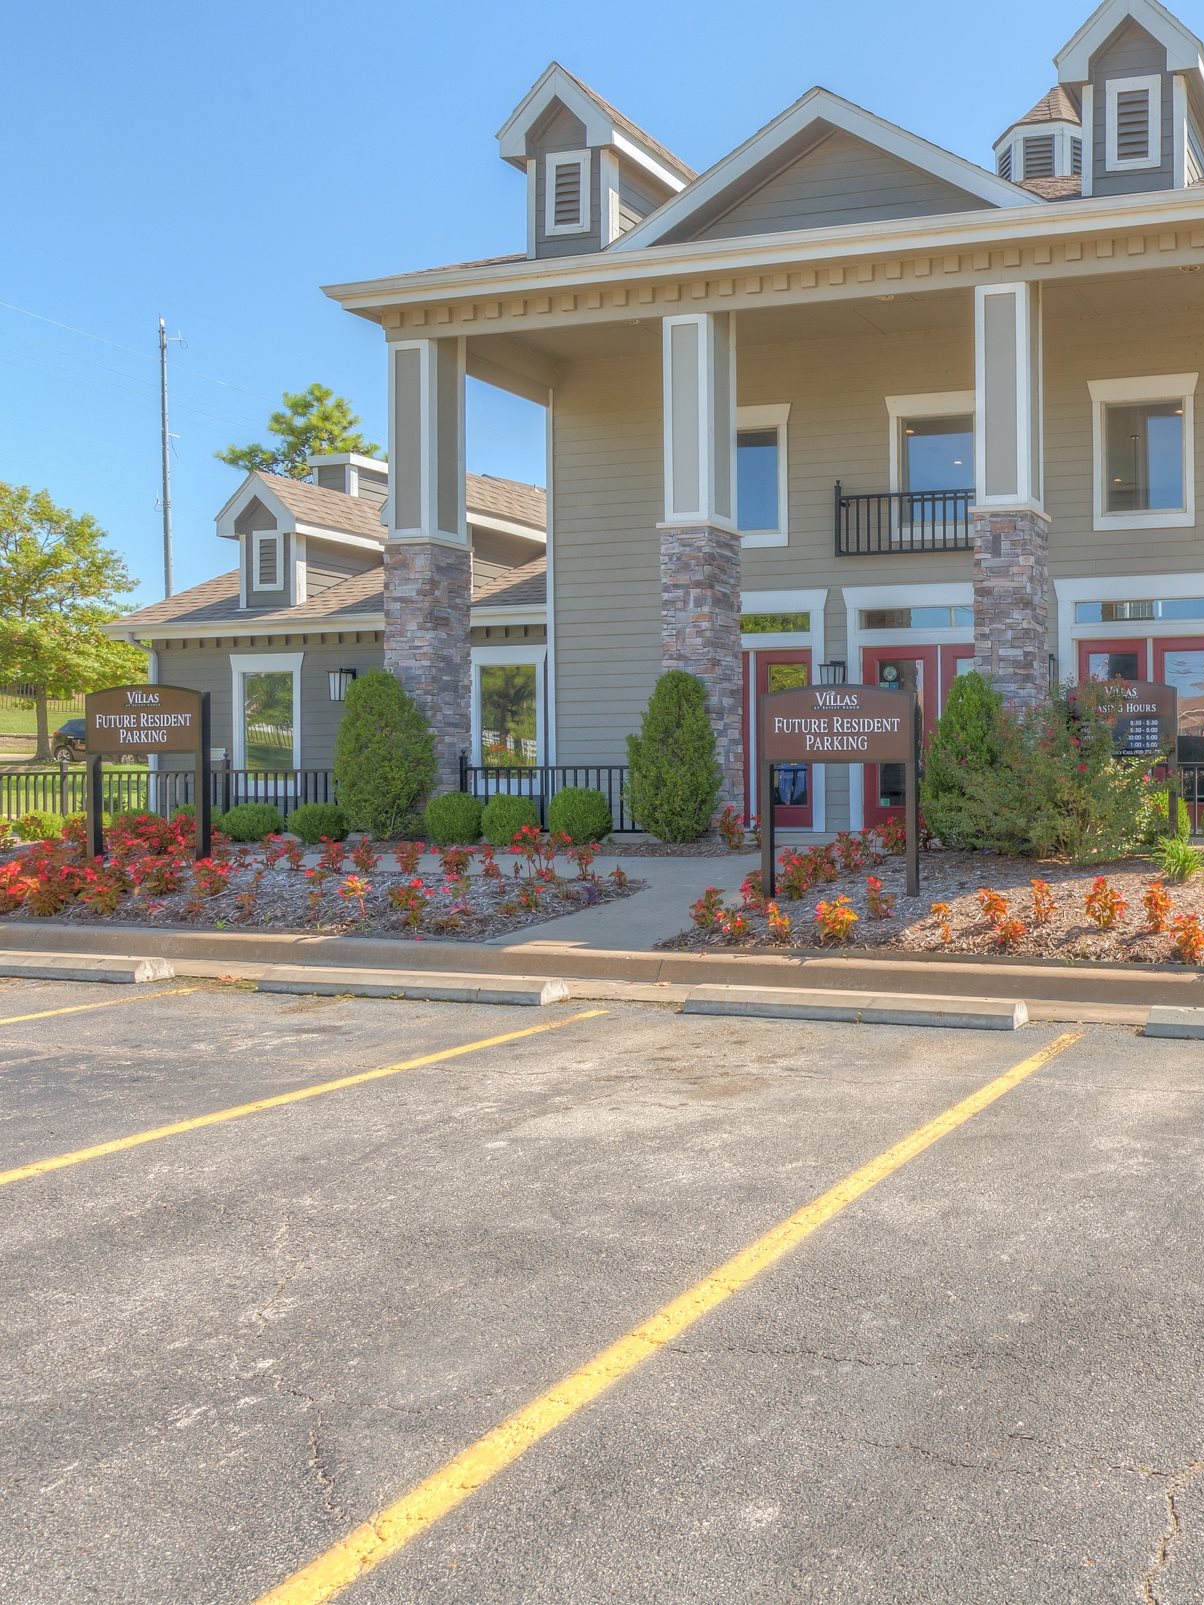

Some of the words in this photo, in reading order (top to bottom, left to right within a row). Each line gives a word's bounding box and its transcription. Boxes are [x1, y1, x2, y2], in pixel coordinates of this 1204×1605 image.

[126, 691, 160, 705] VILLAS
[815, 692, 858, 706] VILLAS
[1126, 703, 1157, 713] HOURS
[96, 714, 137, 728] FUTURE
[140, 712, 192, 727] RESIDENT
[774, 717, 829, 733] FUTURE
[832, 716, 901, 733] RESIDENT
[120, 729, 167, 743] PARKING
[805, 734, 868, 752] PARKING
